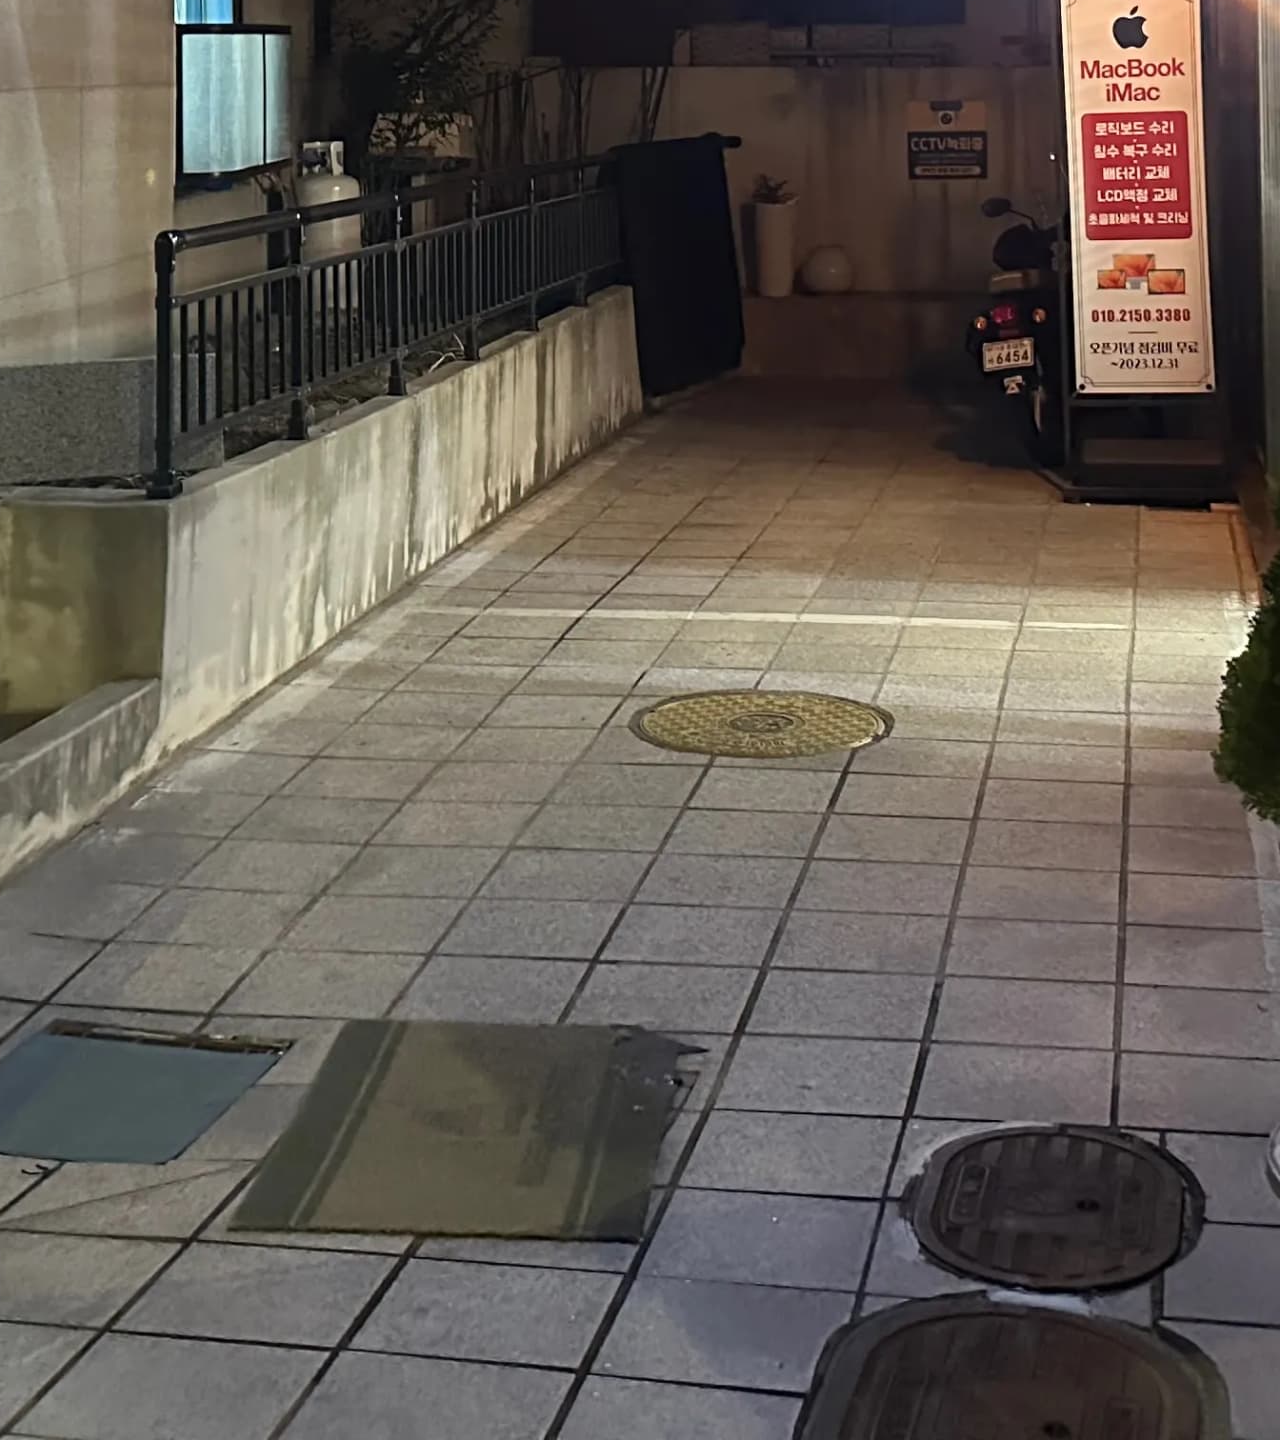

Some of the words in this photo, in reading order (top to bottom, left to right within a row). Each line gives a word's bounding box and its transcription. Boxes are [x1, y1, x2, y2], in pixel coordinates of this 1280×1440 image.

[1080, 58, 1185, 79] MacBook
[1106, 83, 1161, 102] iMac
[1095, 122, 1146, 136] 로직보드
[1149, 121, 1174, 135] 수리
[1152, 143, 1177, 157] 수리
[1103, 166, 1141, 180] 배터리
[1145, 166, 1170, 180] 교체
[1152, 188, 1177, 203] 교체
[1091, 309, 1191, 323] 010.2150.3380
